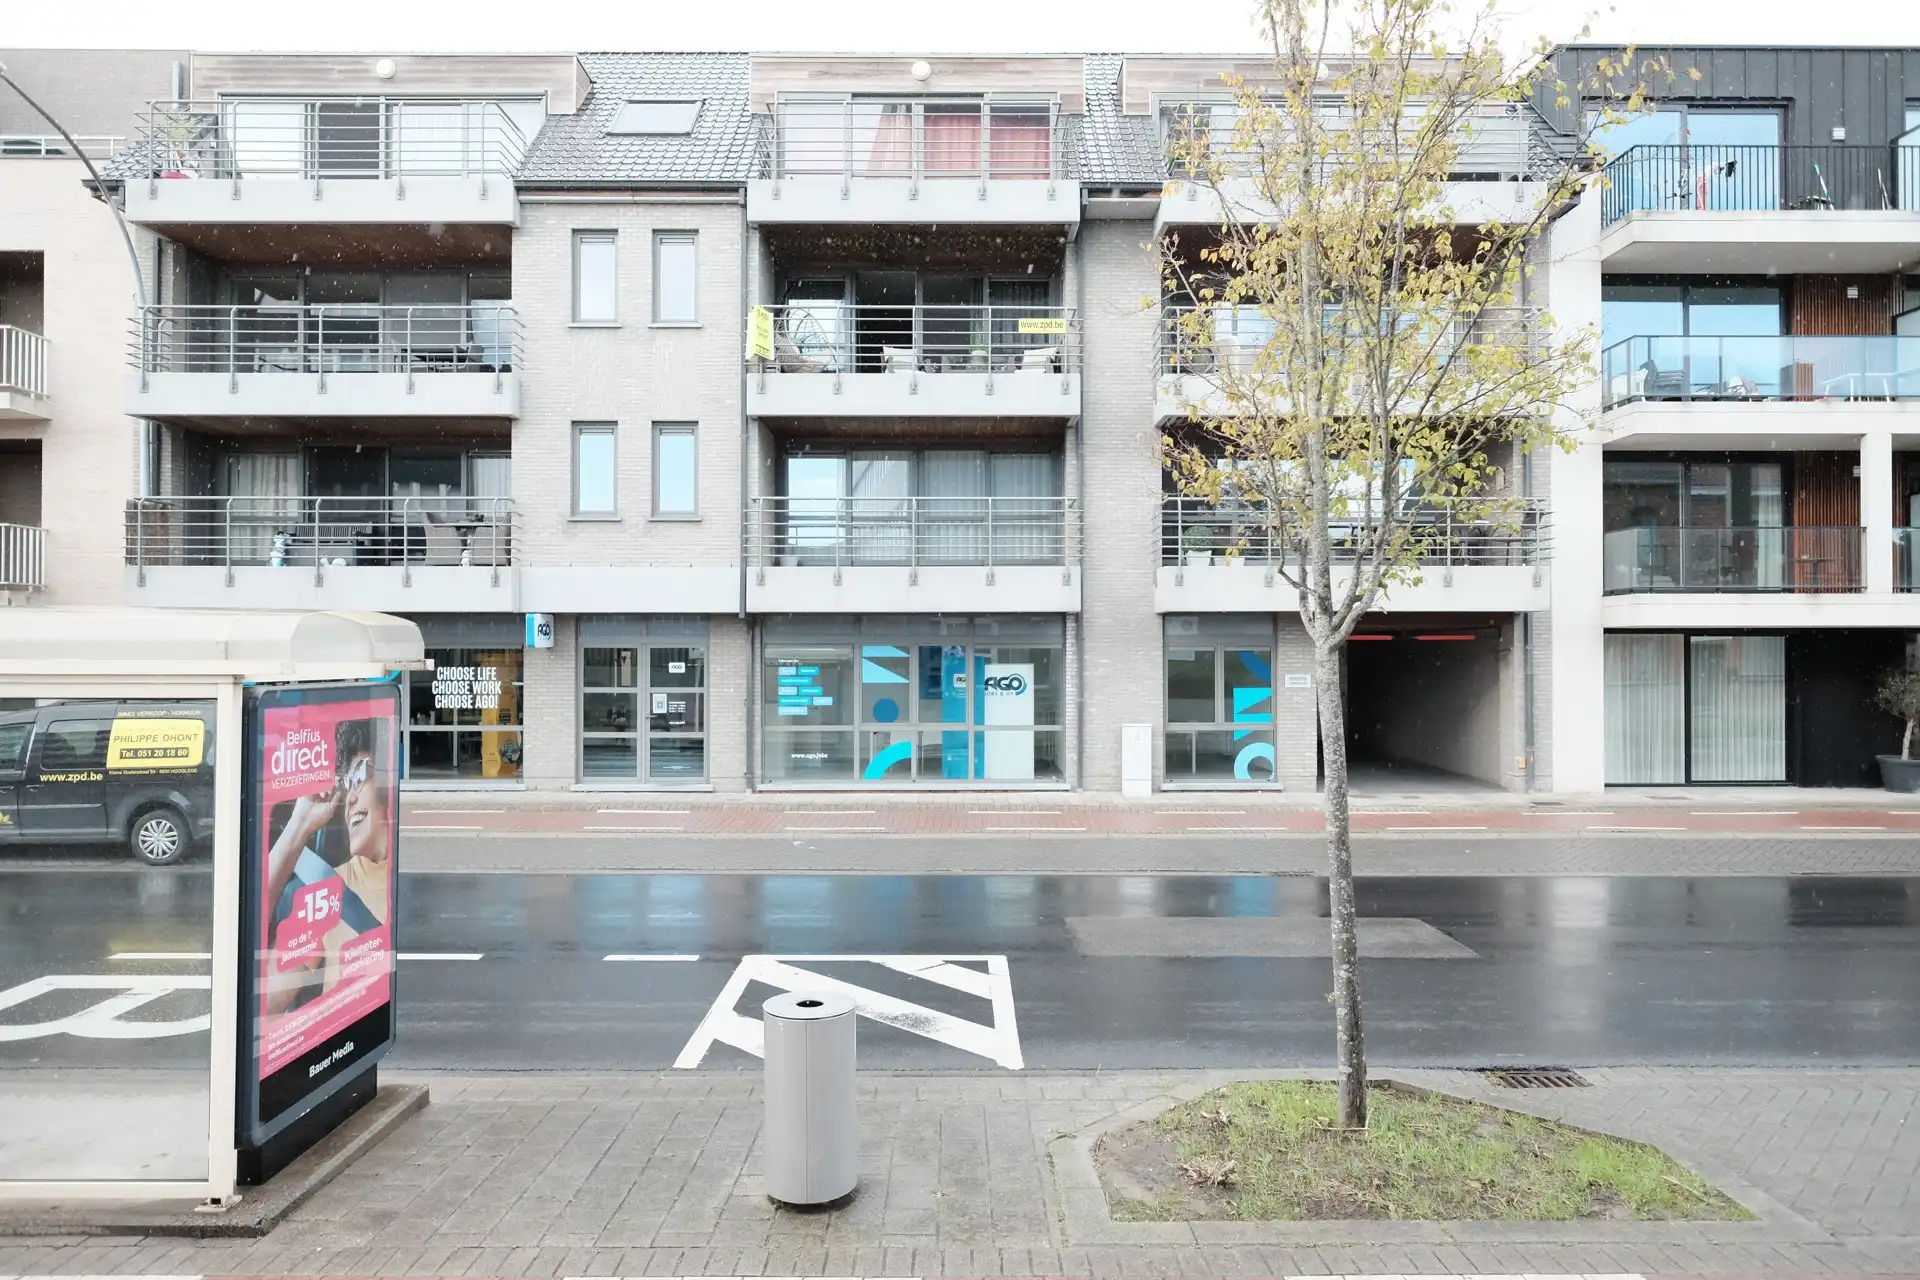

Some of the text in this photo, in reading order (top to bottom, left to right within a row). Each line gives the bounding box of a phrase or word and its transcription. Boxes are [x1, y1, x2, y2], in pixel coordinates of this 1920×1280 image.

[1020, 321, 1064, 330] www.zpd.be
[436, 666, 497, 681] CHOOSE LIFE
[431, 680, 502, 695] CHOOSE WORK
[984, 676, 1024, 691] AGO
[434, 694, 498, 709] CHOOSE AGO!
[113, 734, 159, 743] PHILIPPE
[286, 728, 321, 746] Belfius
[121, 750, 136, 758] Tel.
[137, 749, 152, 757] 051
[153, 749, 164, 757] 20
[166, 749, 176, 757] 18
[271, 740, 329, 775] direct
[40, 772, 104, 783] www.zpd.be
[271, 769, 330, 790] VERZEKERINGEN
[287, 937, 298, 948] op
[298, 932, 308, 943] de
[309, 1040, 355, 1078] Bauer Media
